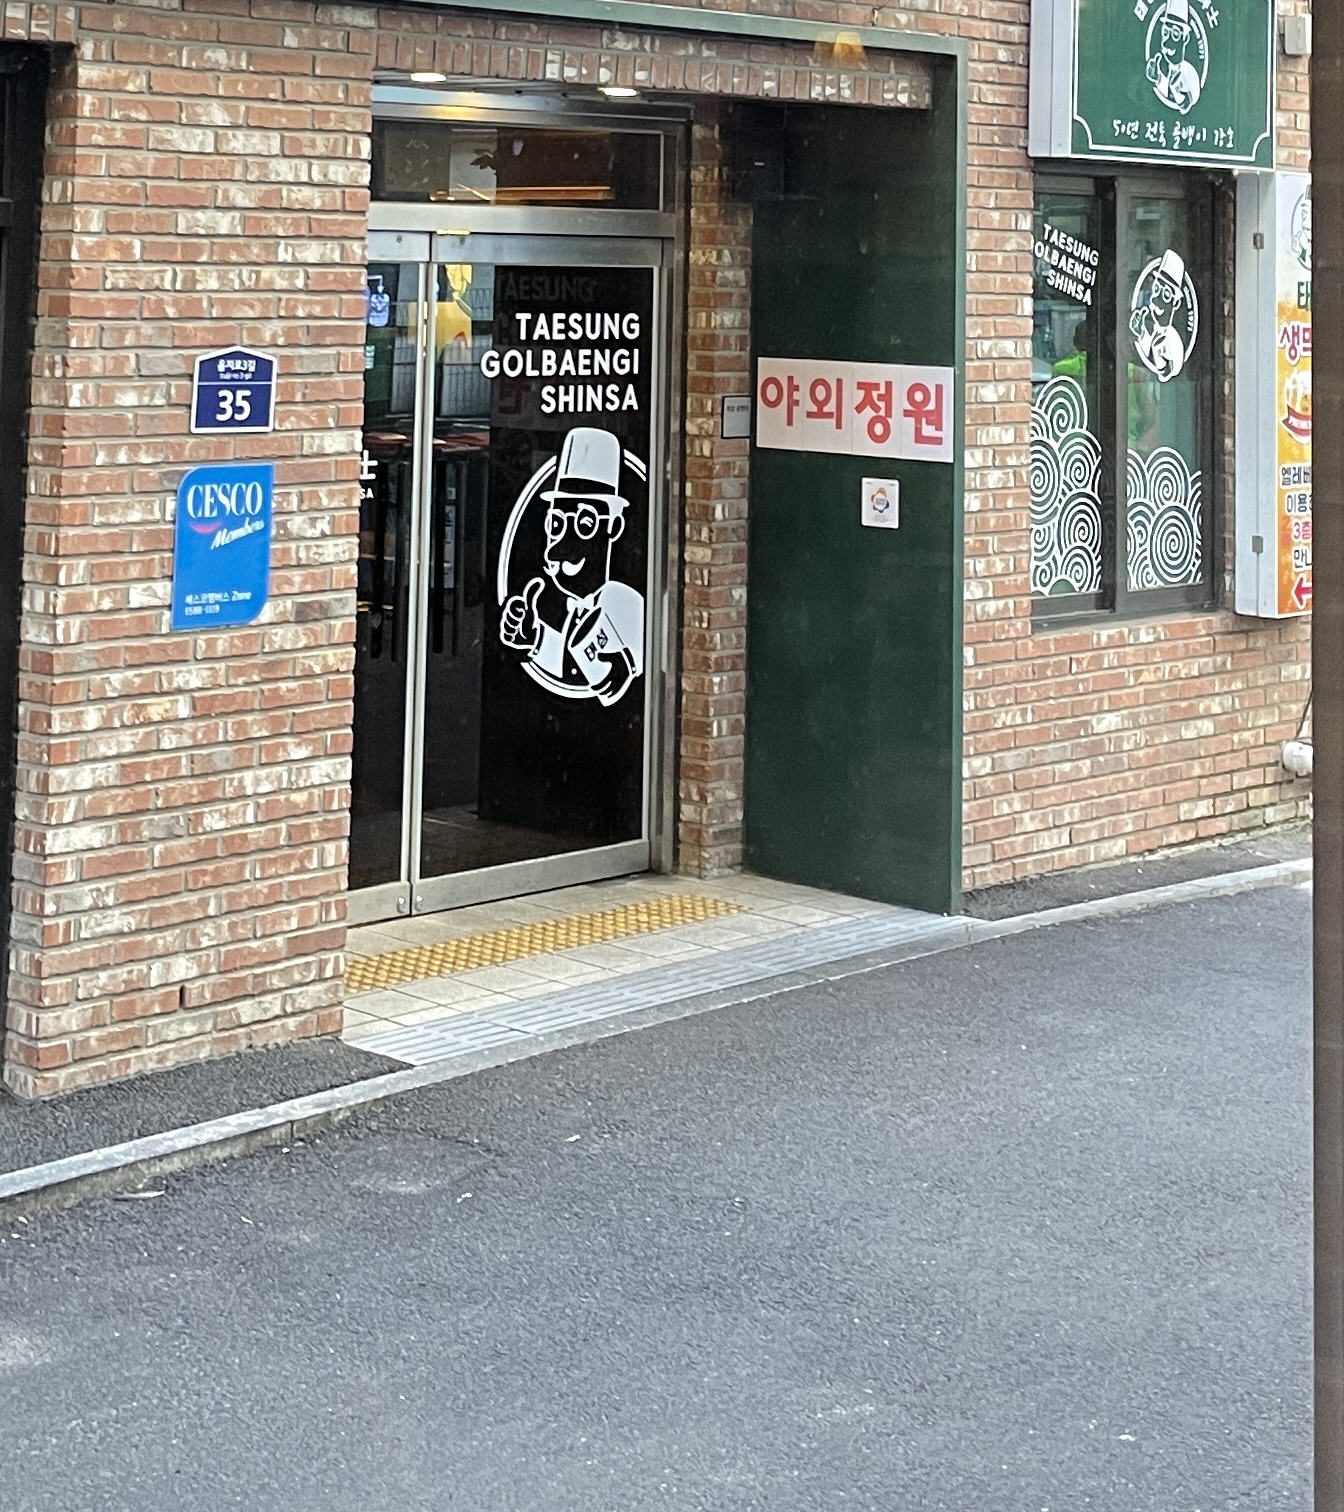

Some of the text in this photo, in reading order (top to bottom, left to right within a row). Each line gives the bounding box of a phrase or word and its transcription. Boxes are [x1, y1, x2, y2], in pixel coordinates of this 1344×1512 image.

[1043, 222, 1099, 267] TAESUNG
[1035, 241, 1096, 287] OLBAENGI
[1046, 268, 1093, 306] SHINSA
[515, 311, 641, 342] TAESUNG
[481, 347, 640, 378] GOLBAENGI
[215, 389, 252, 422] 35
[539, 383, 639, 414] SHINSA
[760, 374, 944, 446] 야외정원
[187, 481, 263, 519] CESCO
